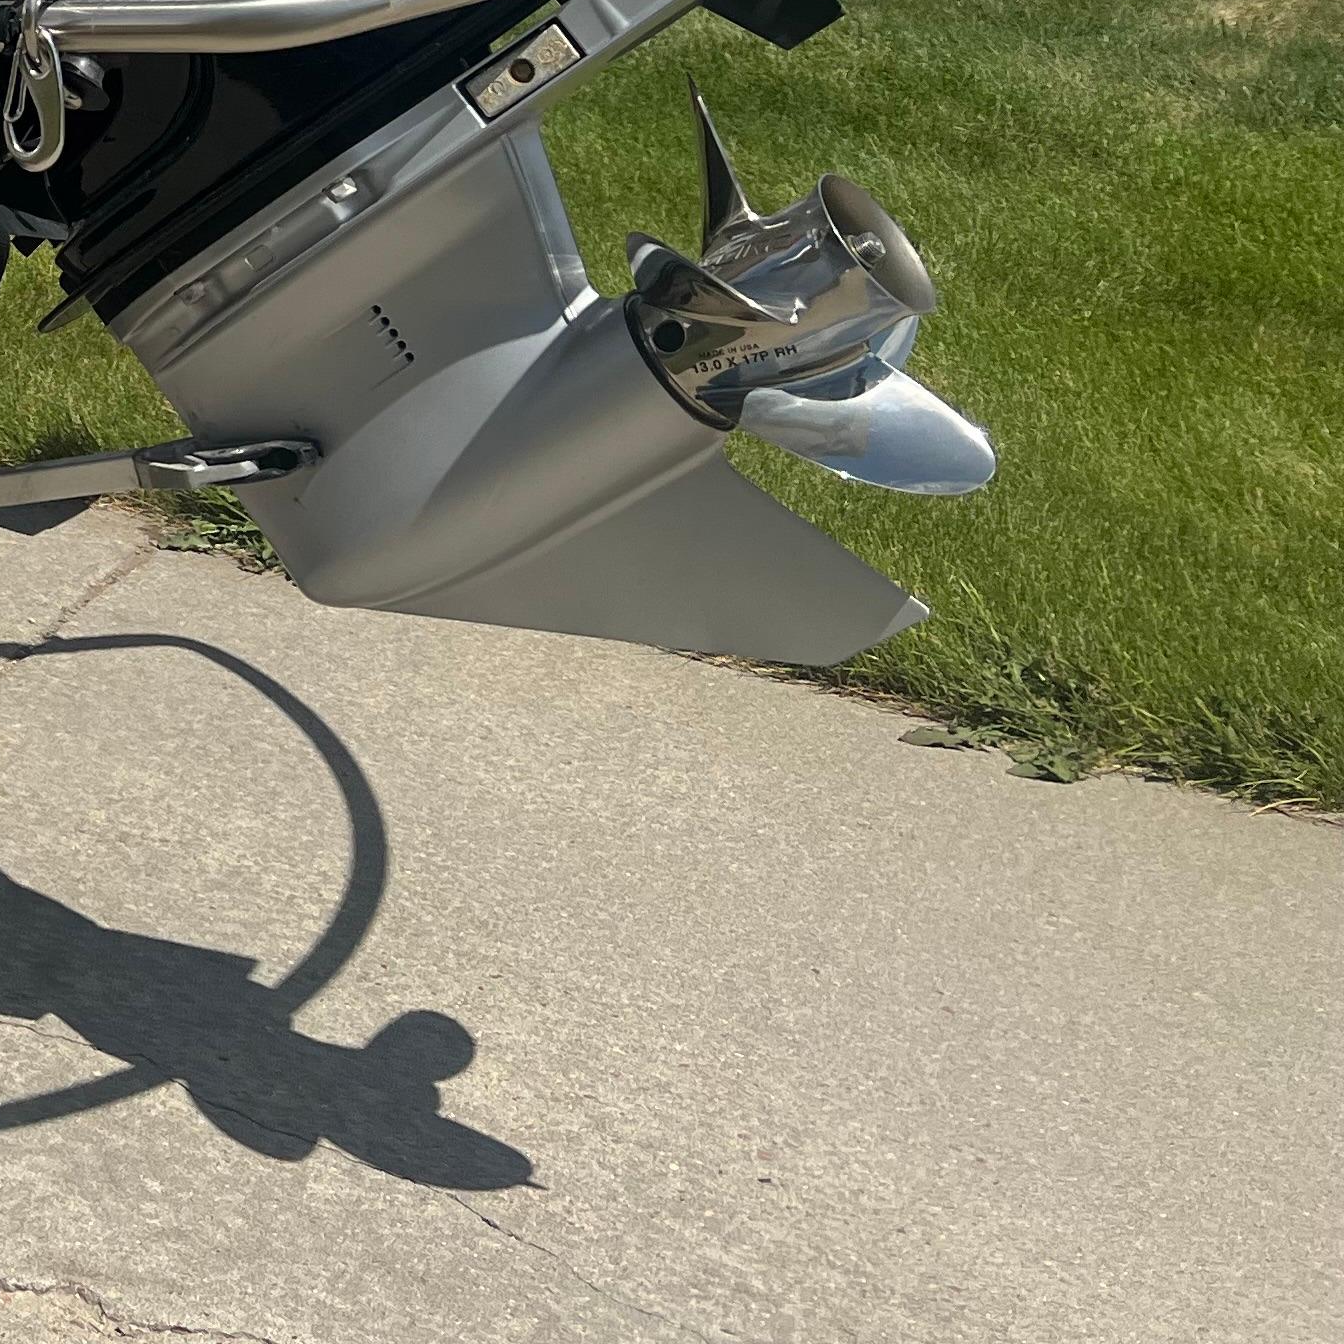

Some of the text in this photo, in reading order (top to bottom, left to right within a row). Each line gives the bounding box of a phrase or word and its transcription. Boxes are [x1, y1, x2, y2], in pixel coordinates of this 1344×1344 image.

[690, 359, 723, 374] 13.0
[742, 350, 769, 364] 17P
[774, 344, 798, 358] RH
[698, 343, 760, 358] MADE IN USA
